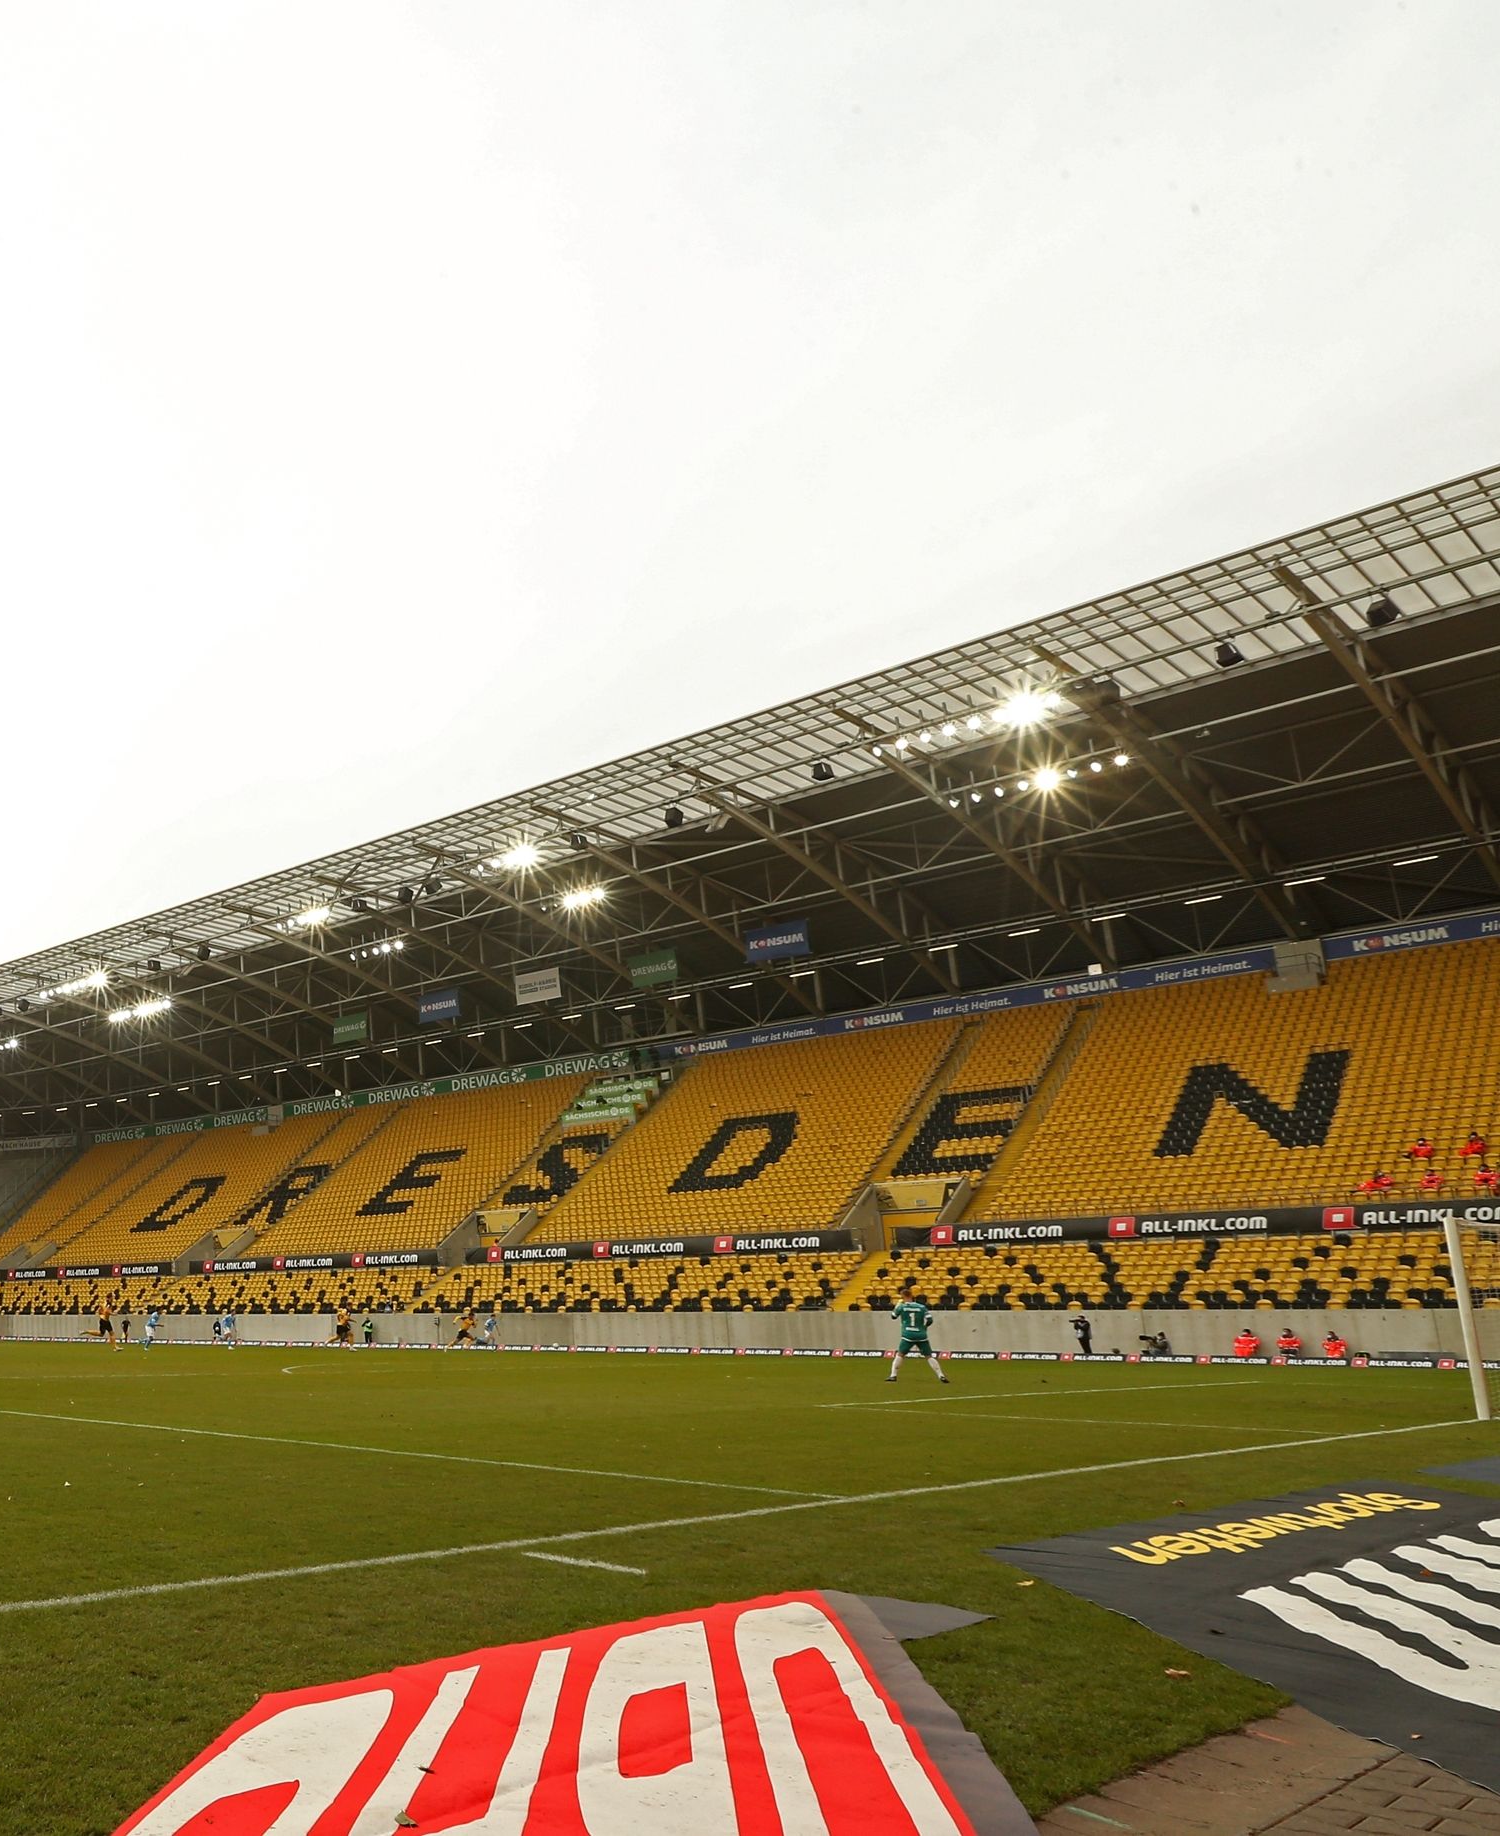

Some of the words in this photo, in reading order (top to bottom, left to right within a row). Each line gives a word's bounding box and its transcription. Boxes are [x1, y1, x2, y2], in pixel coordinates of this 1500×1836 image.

[750, 932, 804, 950] KONSUM
[1352, 926, 1449, 952] KONSUM
[630, 962, 667, 977] DREWAG
[1155, 971, 1180, 982] Hier
[1182, 968, 1198, 978] ist
[1200, 960, 1252, 976] Heimat.
[1043, 978, 1118, 999] KONSUM
[421, 999, 457, 1013] KONSUM
[933, 1006, 954, 1016] Hier
[956, 1003, 969, 1012] ist
[971, 997, 1012, 1010] Heimat.
[844, 1012, 904, 1030] KONSUM
[752, 1034, 769, 1044] Hier
[770, 1032, 782, 1041] ist
[674, 1040, 728, 1055] KONSUM
[544, 1056, 610, 1078] DREWAG
[451, 1071, 510, 1091] DREWAG
[368, 1085, 419, 1104] DREWAG
[293, 1098, 340, 1115] DREWAG
[213, 1112, 254, 1127] DREWAG
[94, 1130, 134, 1144] DREWAG
[155, 1122, 193, 1136] DREWAG
[1141, 1216, 1268, 1233] ALL-INKL.COM
[958, 1225, 1062, 1241] ALL-INKL.COM
[612, 1241, 684, 1255] ALL-INKL.COM
[736, 1236, 820, 1250] ALL-INKL.COM
[504, 1247, 566, 1259] ALL-INKL.COM
[908, 1312, 916, 1326] 1
[1108, 1492, 1442, 1565] Sportwetten
